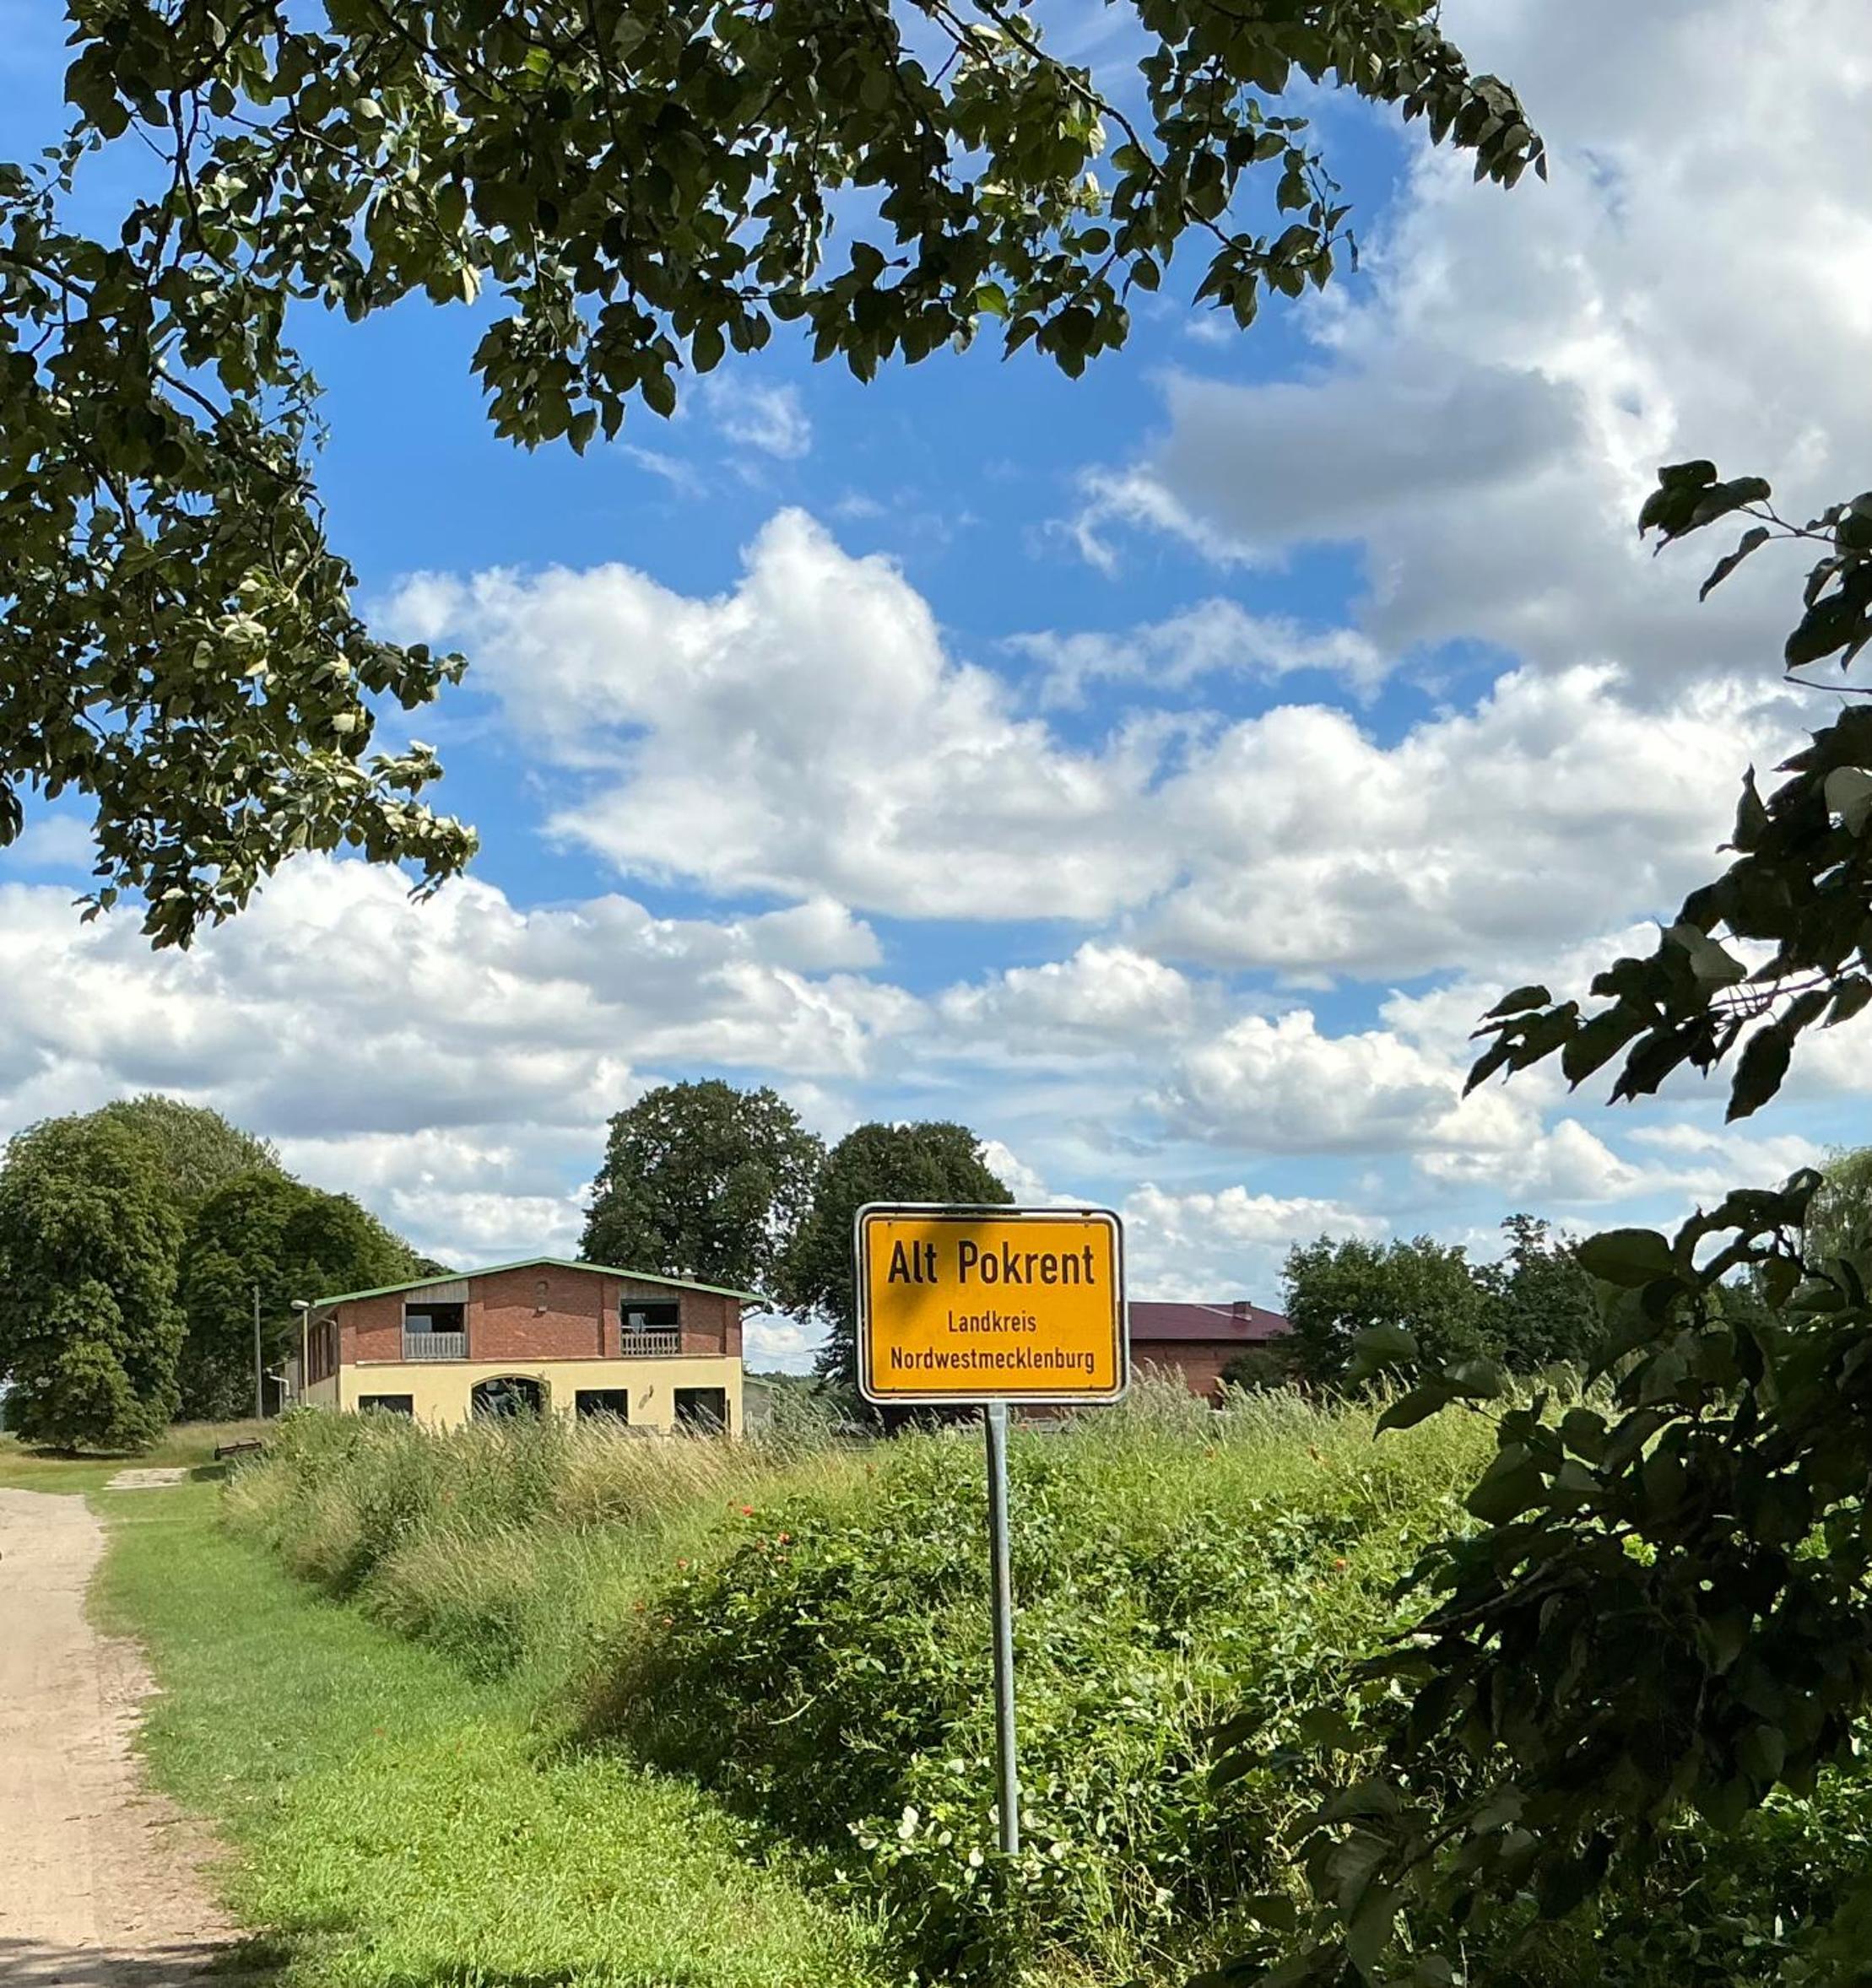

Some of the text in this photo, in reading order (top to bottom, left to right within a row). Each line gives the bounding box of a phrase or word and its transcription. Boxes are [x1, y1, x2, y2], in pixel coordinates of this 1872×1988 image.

[888, 1240, 1095, 1284] Alt Pokrent
[948, 1310, 1036, 1333] Landkreis
[891, 1347, 1095, 1374] Nordwestmecklenburg
